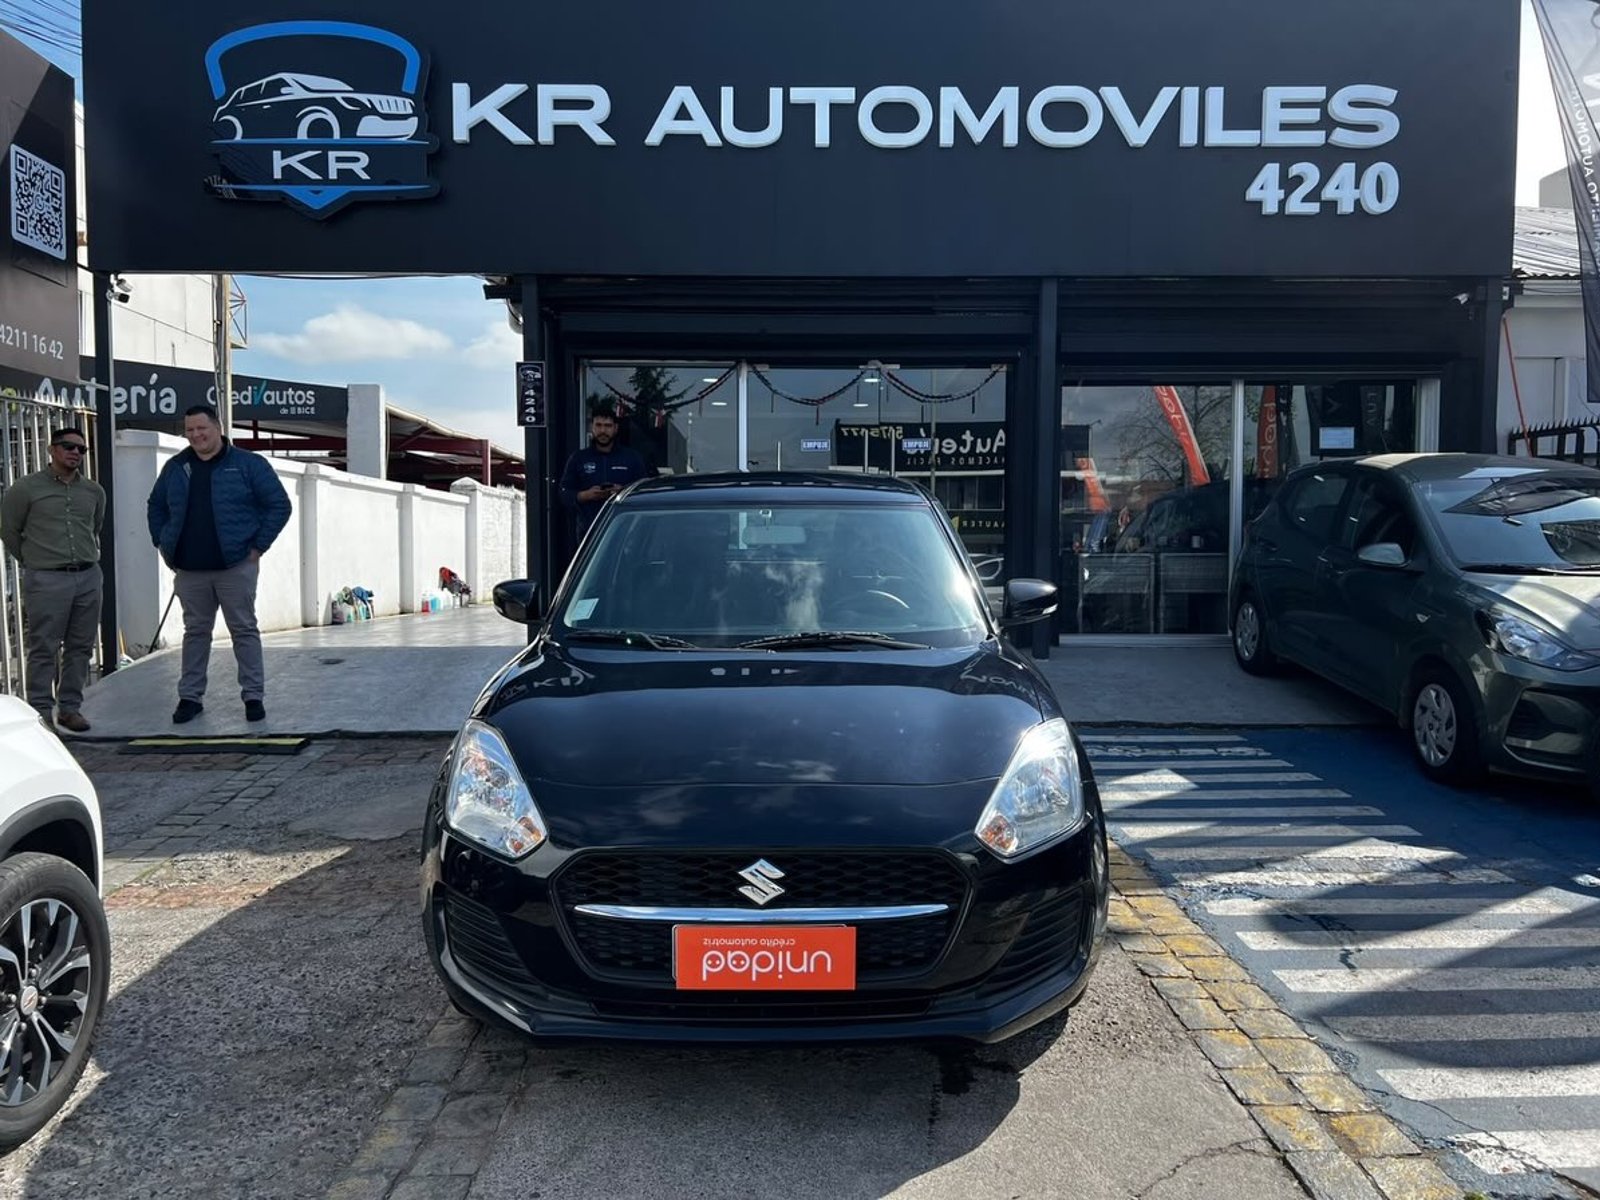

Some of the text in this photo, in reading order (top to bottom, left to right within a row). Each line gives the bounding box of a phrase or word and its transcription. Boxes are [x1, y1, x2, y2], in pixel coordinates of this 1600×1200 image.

[452, 82, 1400, 149] KR AUTOMOVILES
[273, 150, 371, 180] KR
[1245, 161, 1400, 216] 4240
[524, 389, 537, 423] 4240
[703, 937, 796, 948] crédito automotriz
[702, 950, 832, 982] unidad
